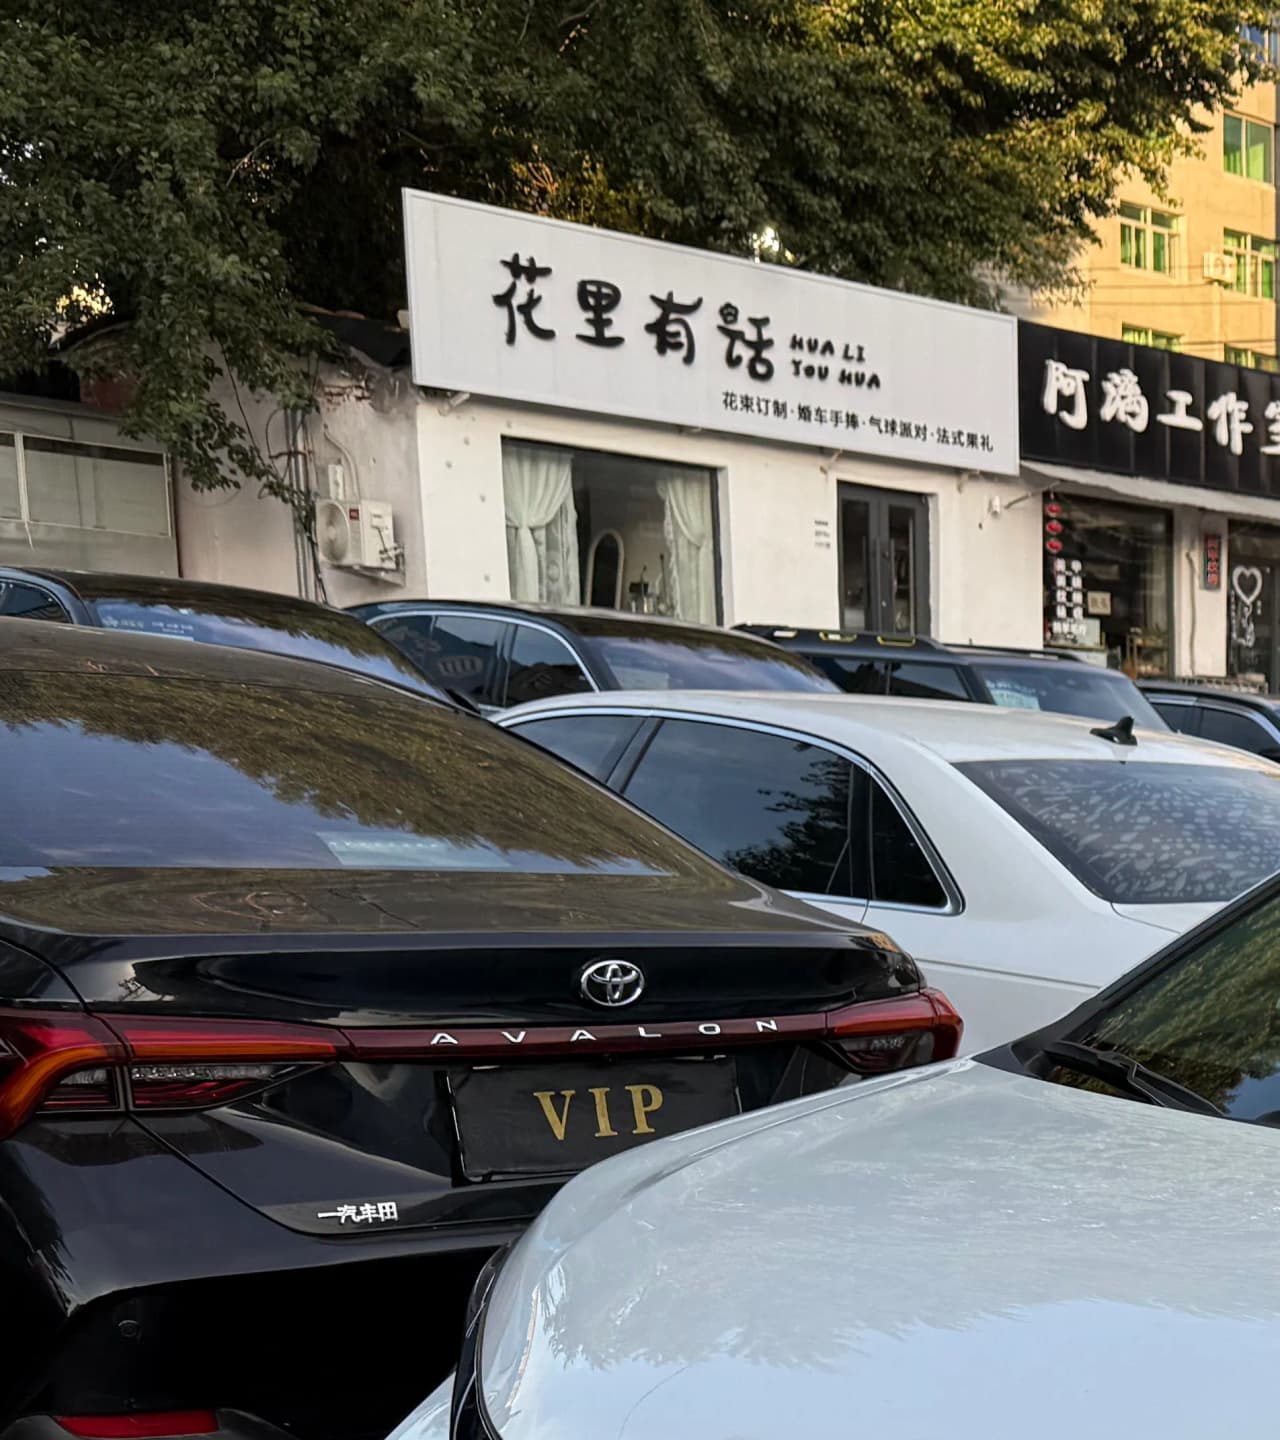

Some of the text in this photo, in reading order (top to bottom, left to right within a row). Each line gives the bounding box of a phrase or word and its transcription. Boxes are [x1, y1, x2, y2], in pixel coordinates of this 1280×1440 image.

[492, 253, 774, 382] 花里有话
[790, 334, 865, 362] HUA LI
[791, 360, 881, 390] YOU HUA
[430, 1019, 778, 1046] AVALON
[533, 1084, 664, 1141] VIP
[317, 1201, 399, 1224] 一汽丰田
